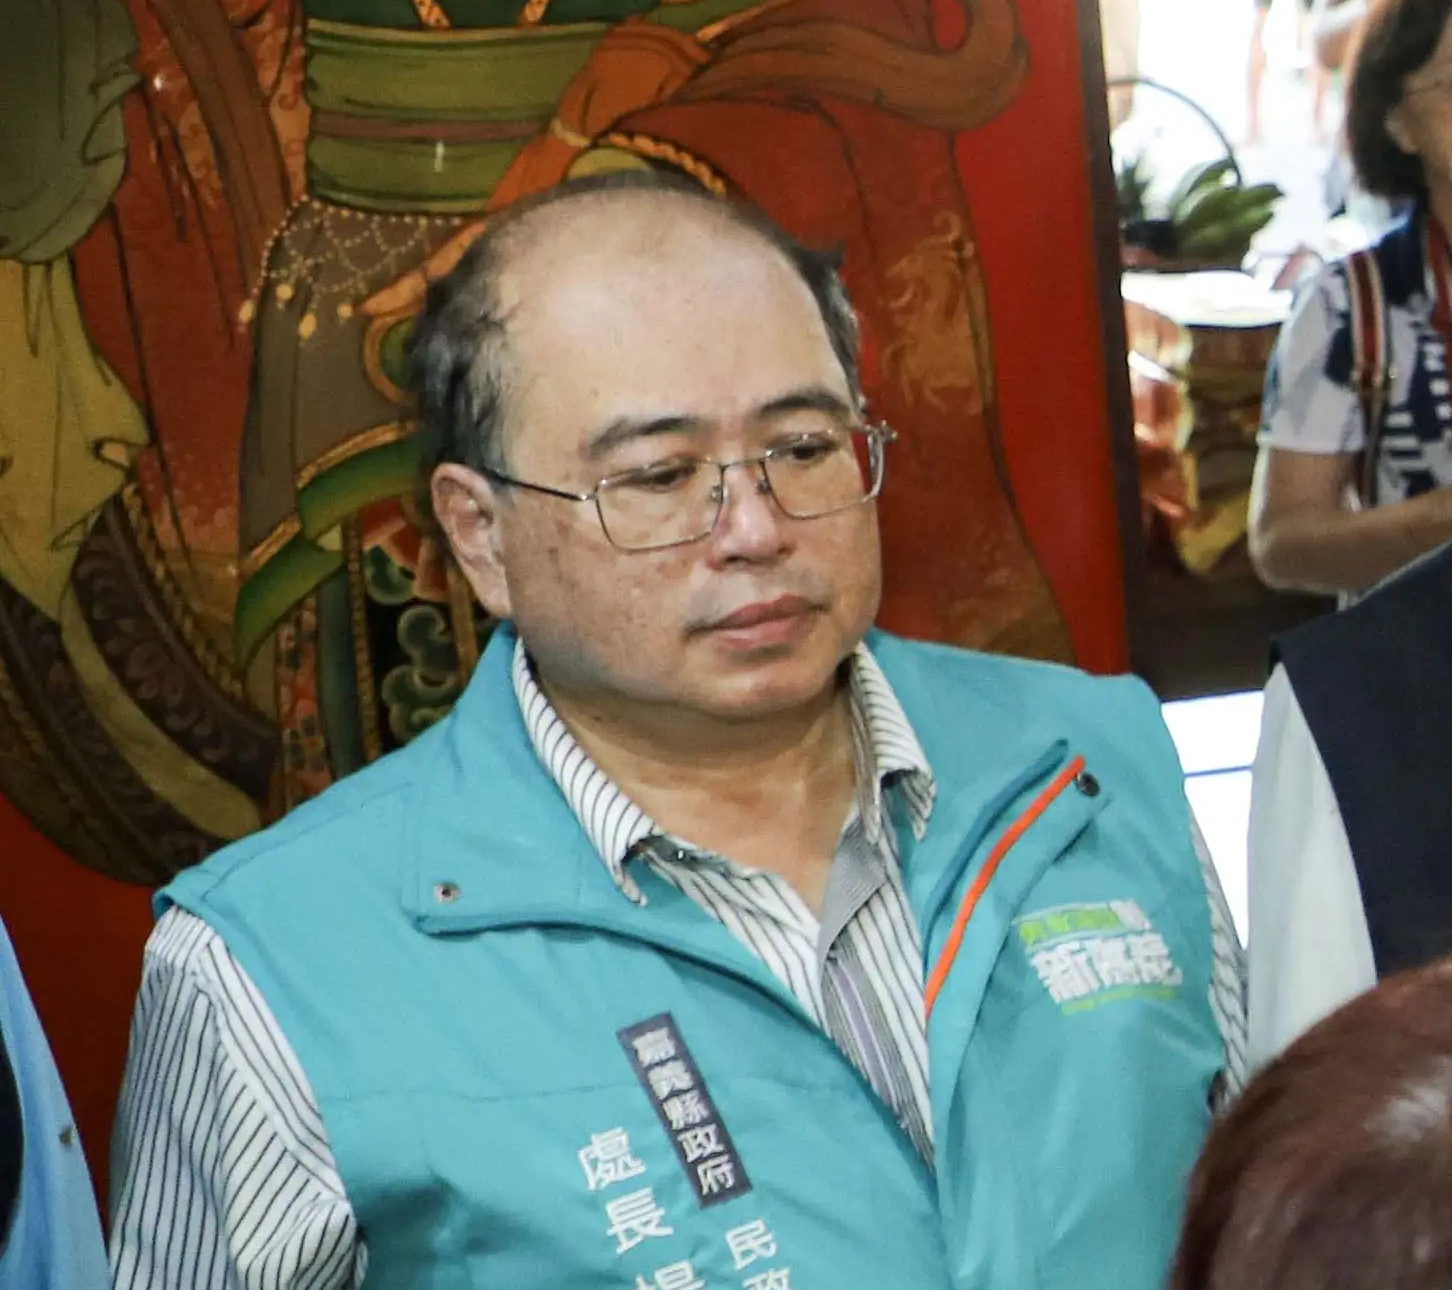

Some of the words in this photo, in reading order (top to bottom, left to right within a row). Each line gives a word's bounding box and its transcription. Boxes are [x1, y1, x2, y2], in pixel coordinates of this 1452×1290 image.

[630, 1026, 738, 1197] 嘉義縣政府
